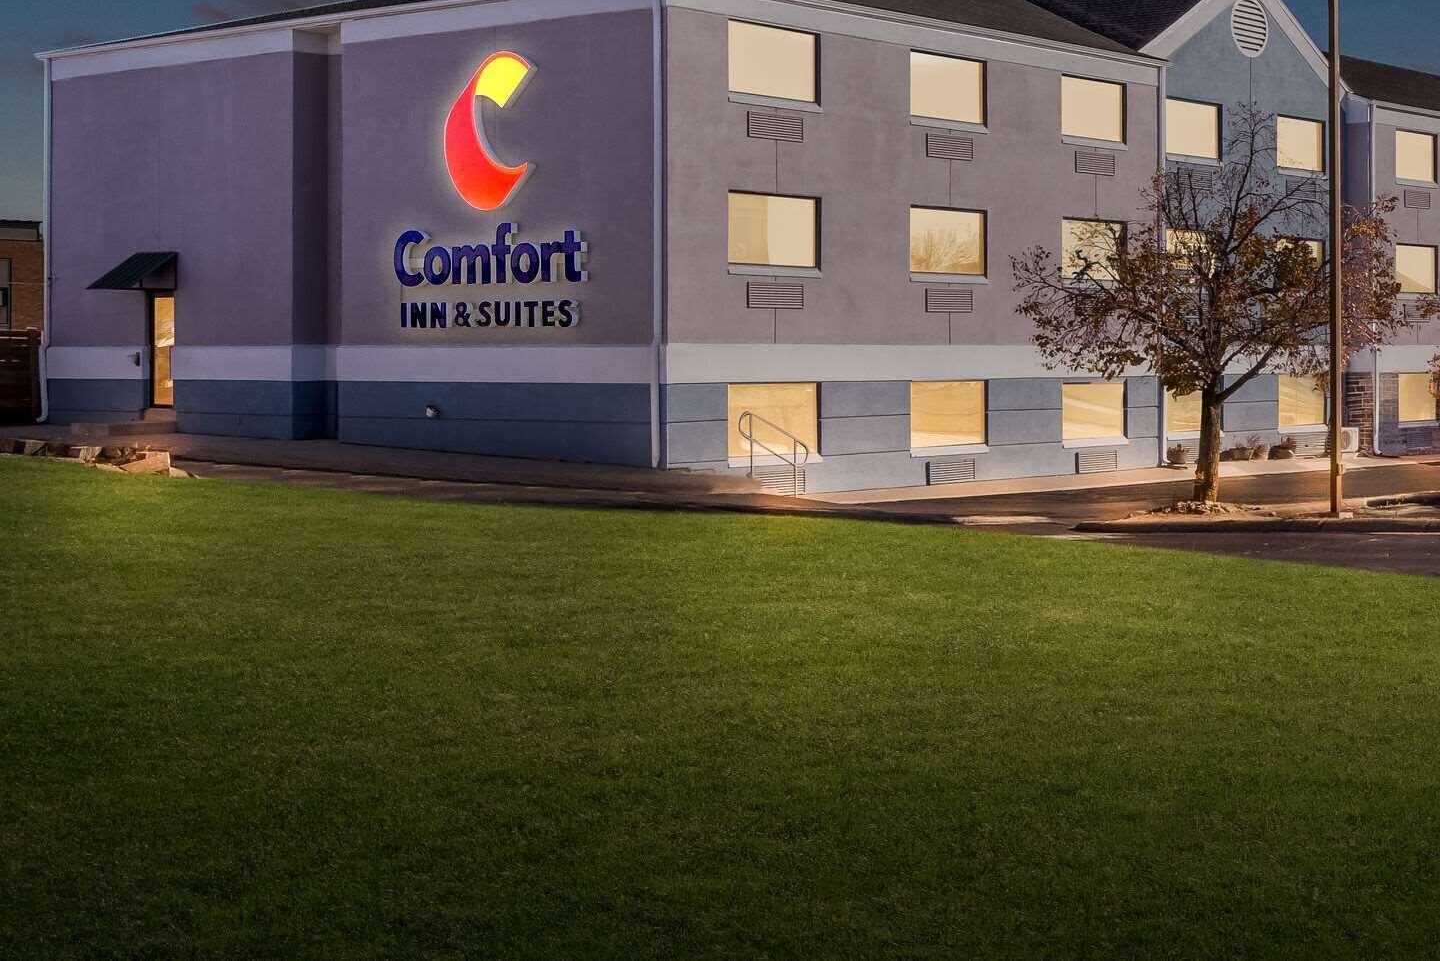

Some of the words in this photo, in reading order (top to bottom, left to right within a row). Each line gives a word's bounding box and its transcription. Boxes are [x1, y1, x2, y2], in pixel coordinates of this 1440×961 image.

[394, 223, 587, 287] Comfort
[401, 302, 447, 328] INN
[454, 301, 472, 328] &
[475, 299, 577, 328] SUITES
